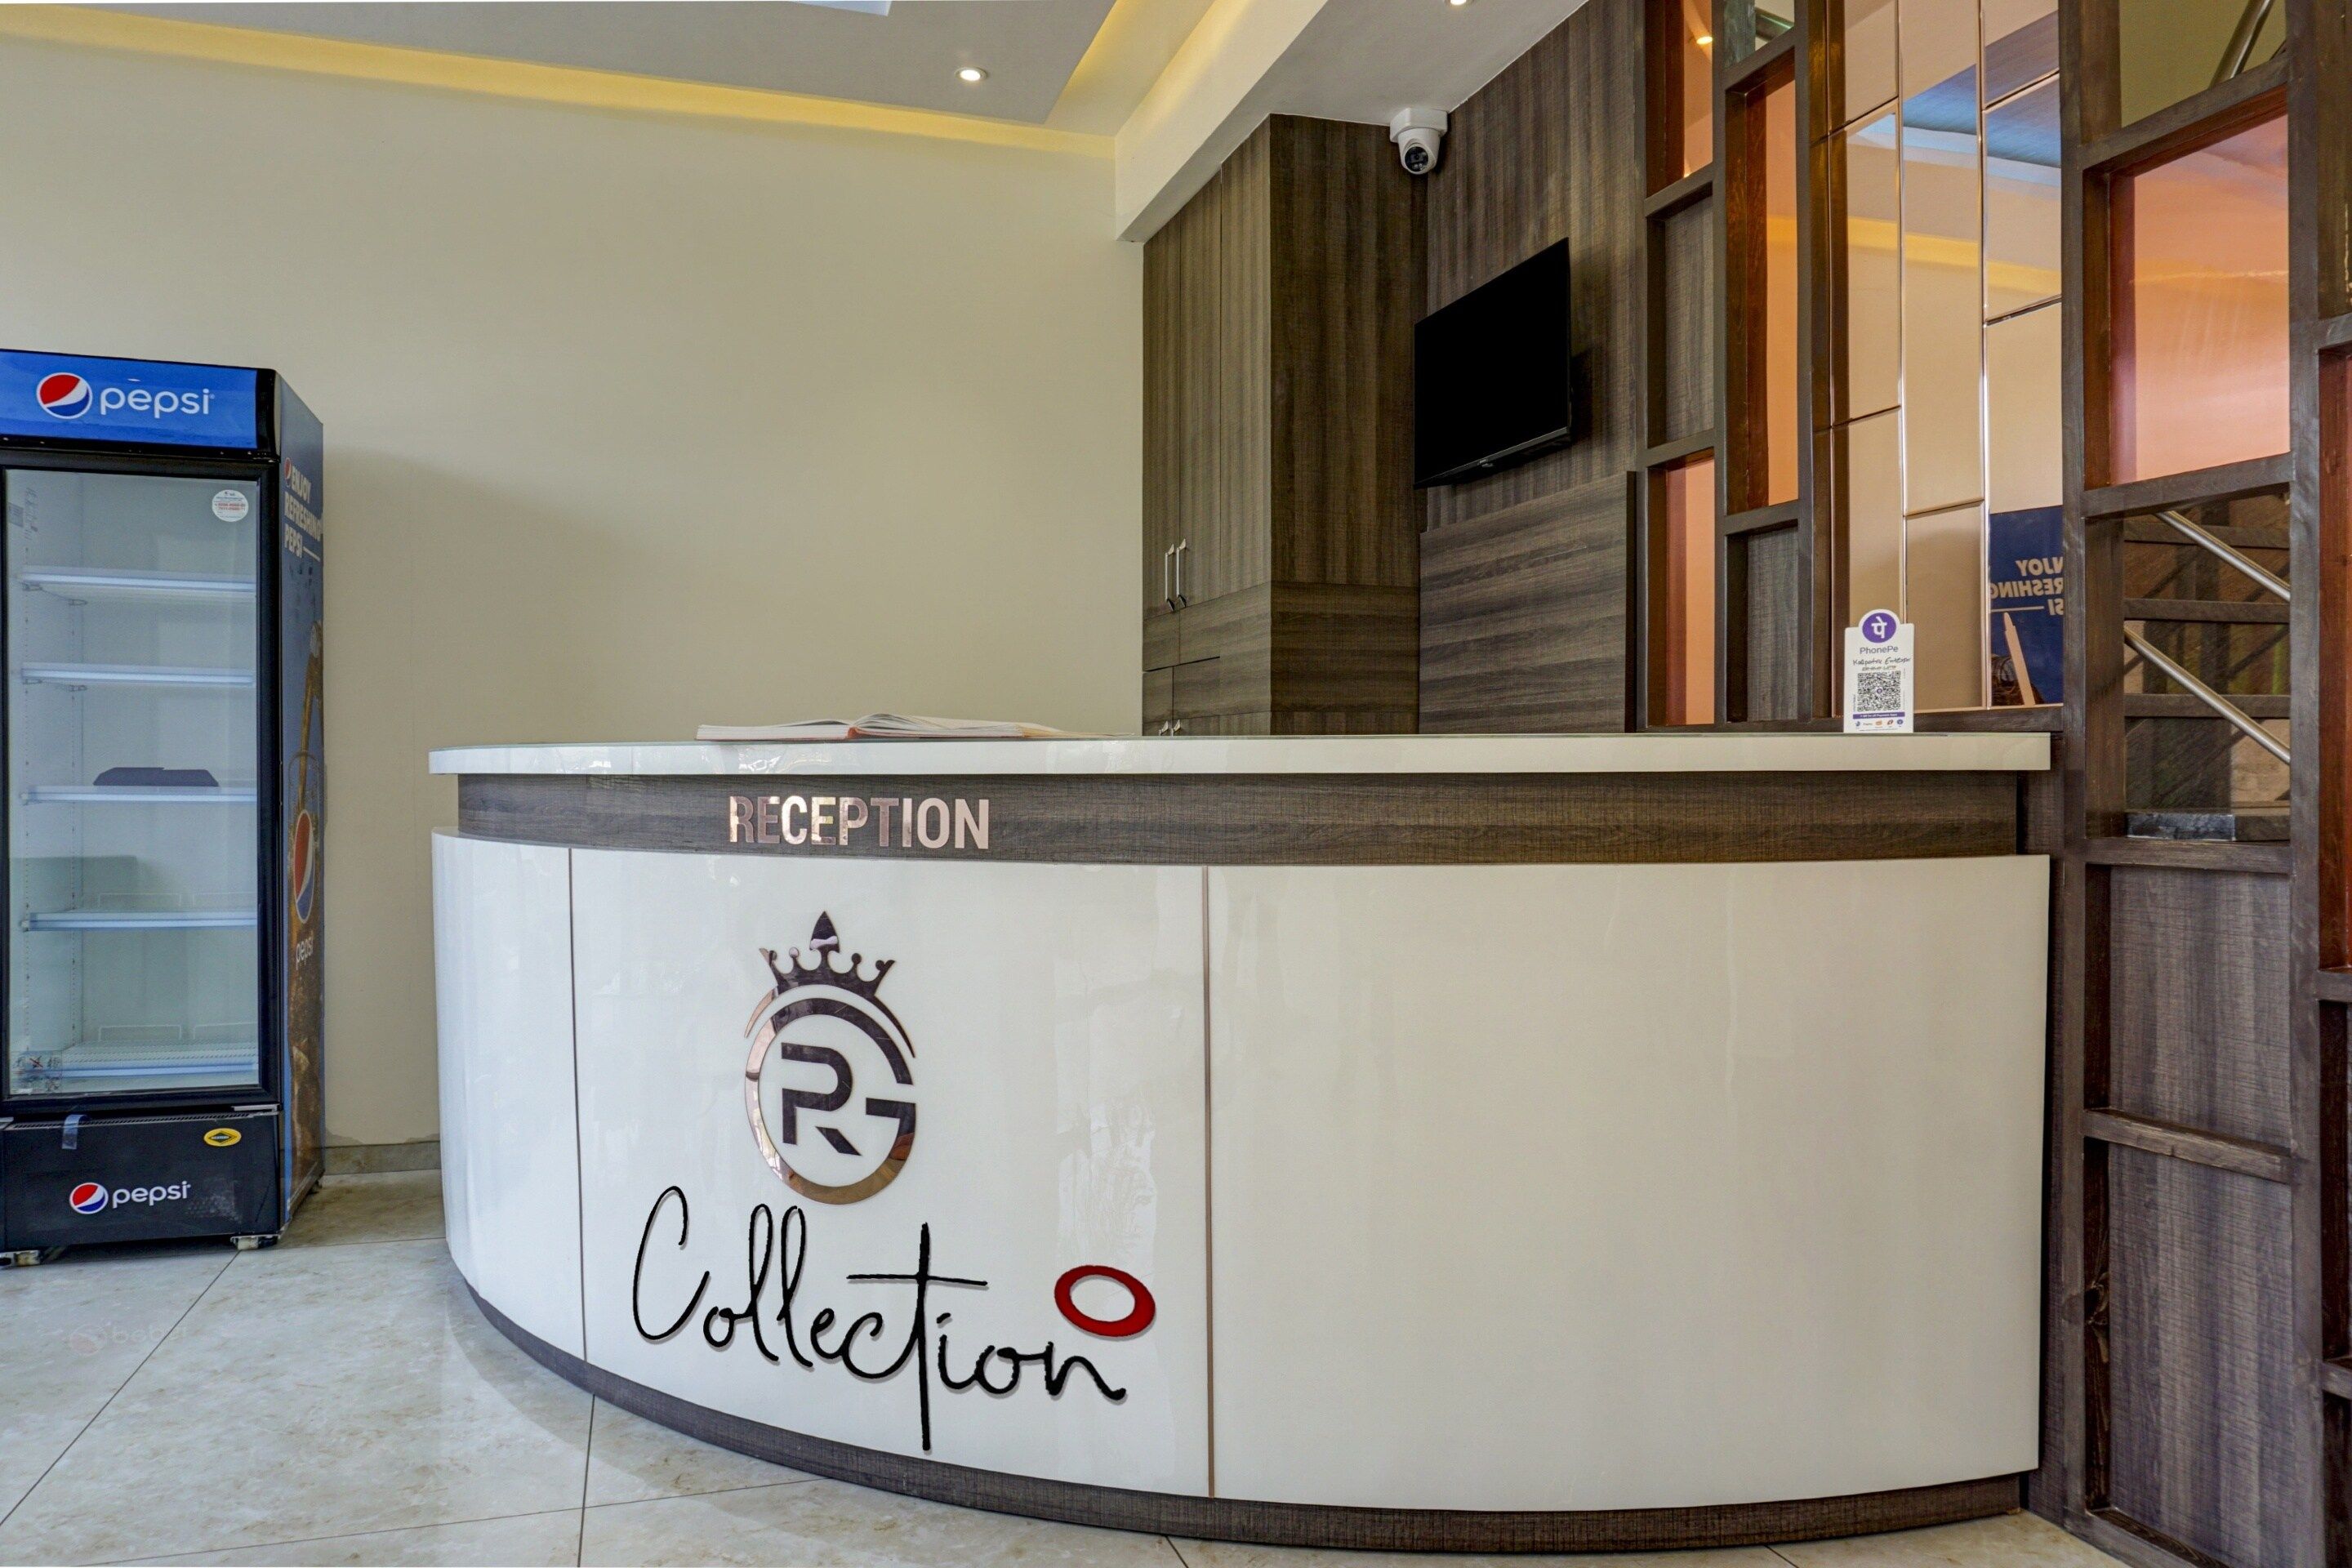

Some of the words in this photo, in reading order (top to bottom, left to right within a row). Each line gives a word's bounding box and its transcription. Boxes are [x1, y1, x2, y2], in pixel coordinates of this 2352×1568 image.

[100, 387, 210, 419] pepsi
[1860, 645, 1899, 654] PhonePe
[729, 795, 990, 849] RECEPTION
[296, 930, 314, 970] pepsi
[112, 1180, 189, 1209] pepsi
[633, 1186, 1127, 1452] Collection
